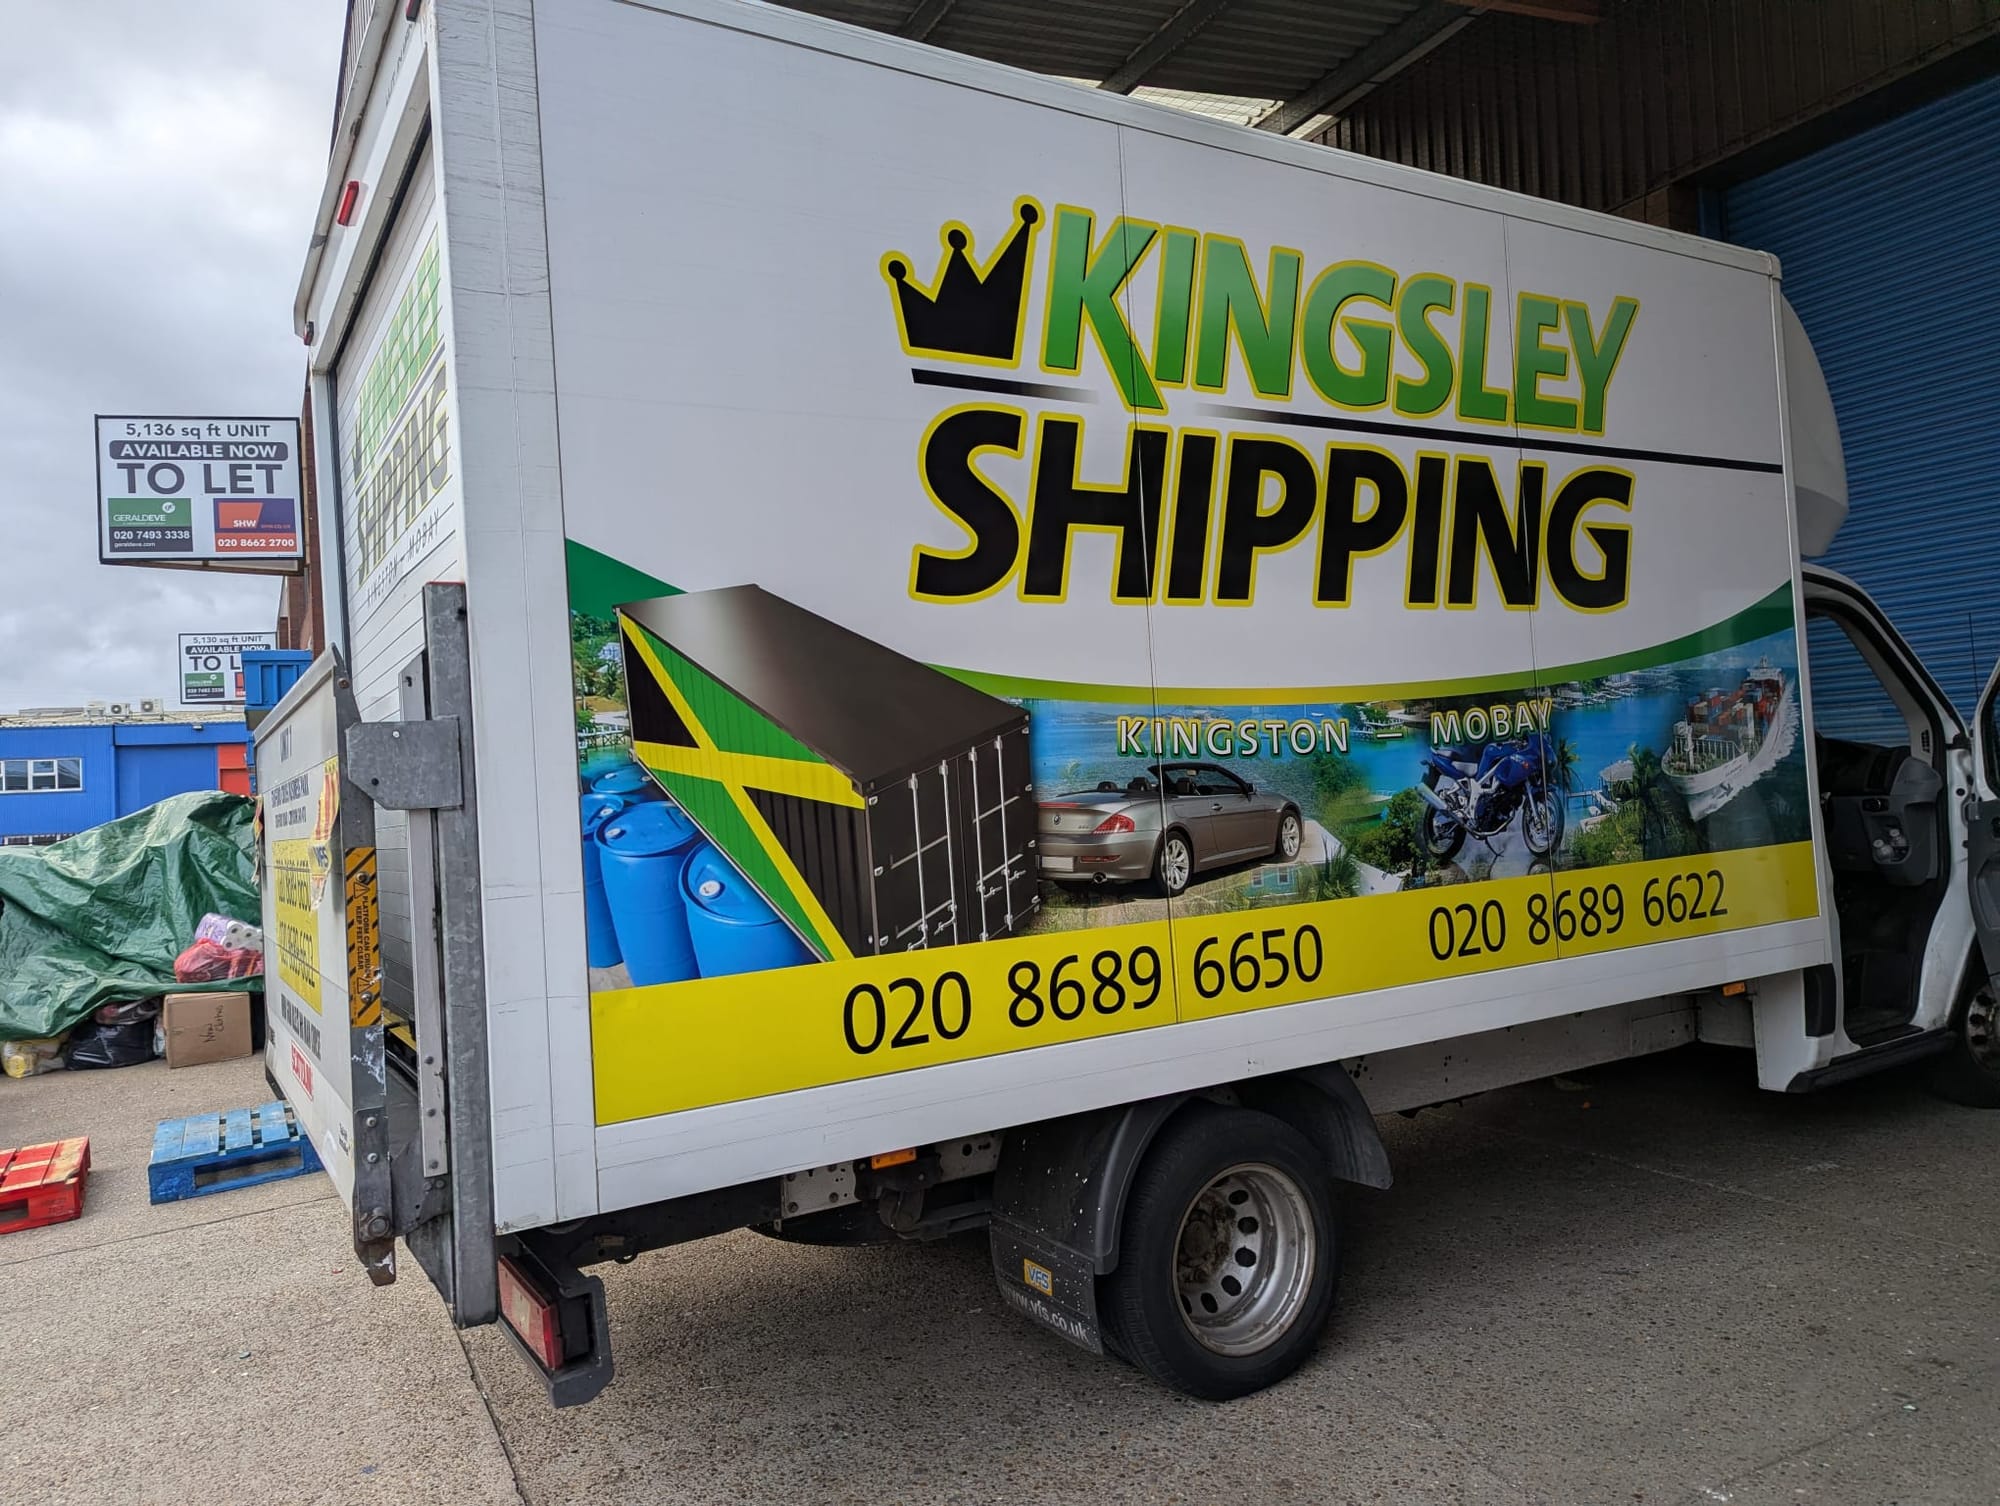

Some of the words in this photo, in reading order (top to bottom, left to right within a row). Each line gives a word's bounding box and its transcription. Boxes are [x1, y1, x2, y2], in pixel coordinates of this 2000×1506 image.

[1039, 204, 1640, 437] KINGSLEY
[126, 423, 175, 437] 5,136
[181, 427, 200, 439] sq
[206, 424, 221, 437] ft
[227, 424, 270, 437] UNIT
[120, 444, 223, 457] AVAILABLE
[229, 444, 277, 458] NOW
[117, 462, 185, 494] TO
[203, 463, 282, 495] LET
[358, 362, 448, 587] SHIPPING
[908, 402, 1636, 614] SHIPPING
[113, 530, 134, 540] 020
[136, 530, 162, 539] 7493
[164, 530, 190, 539] 3338
[233, 519, 257, 528] SHW
[217, 538, 237, 547] 020
[240, 538, 266, 547] 8662
[268, 538, 294, 547] 2700
[190, 646, 240, 654] AVAILABLE
[231, 635, 239, 643] ft
[241, 635, 263, 643] UNIT
[189, 655, 221, 671] TO
[1117, 715, 1351, 760] KINGSTON
[1430, 698, 1553, 747] MOBAY
[362, 895, 370, 934] PLATFORM
[1427, 897, 1506, 961] 020
[1528, 882, 1626, 946] 8689
[1643, 869, 1729, 928] 6622
[843, 969, 972, 1055] 020
[1006, 944, 1164, 1028] 8689
[1193, 922, 1324, 1000] 6650
[1028, 1265, 1049, 1290] VFS
